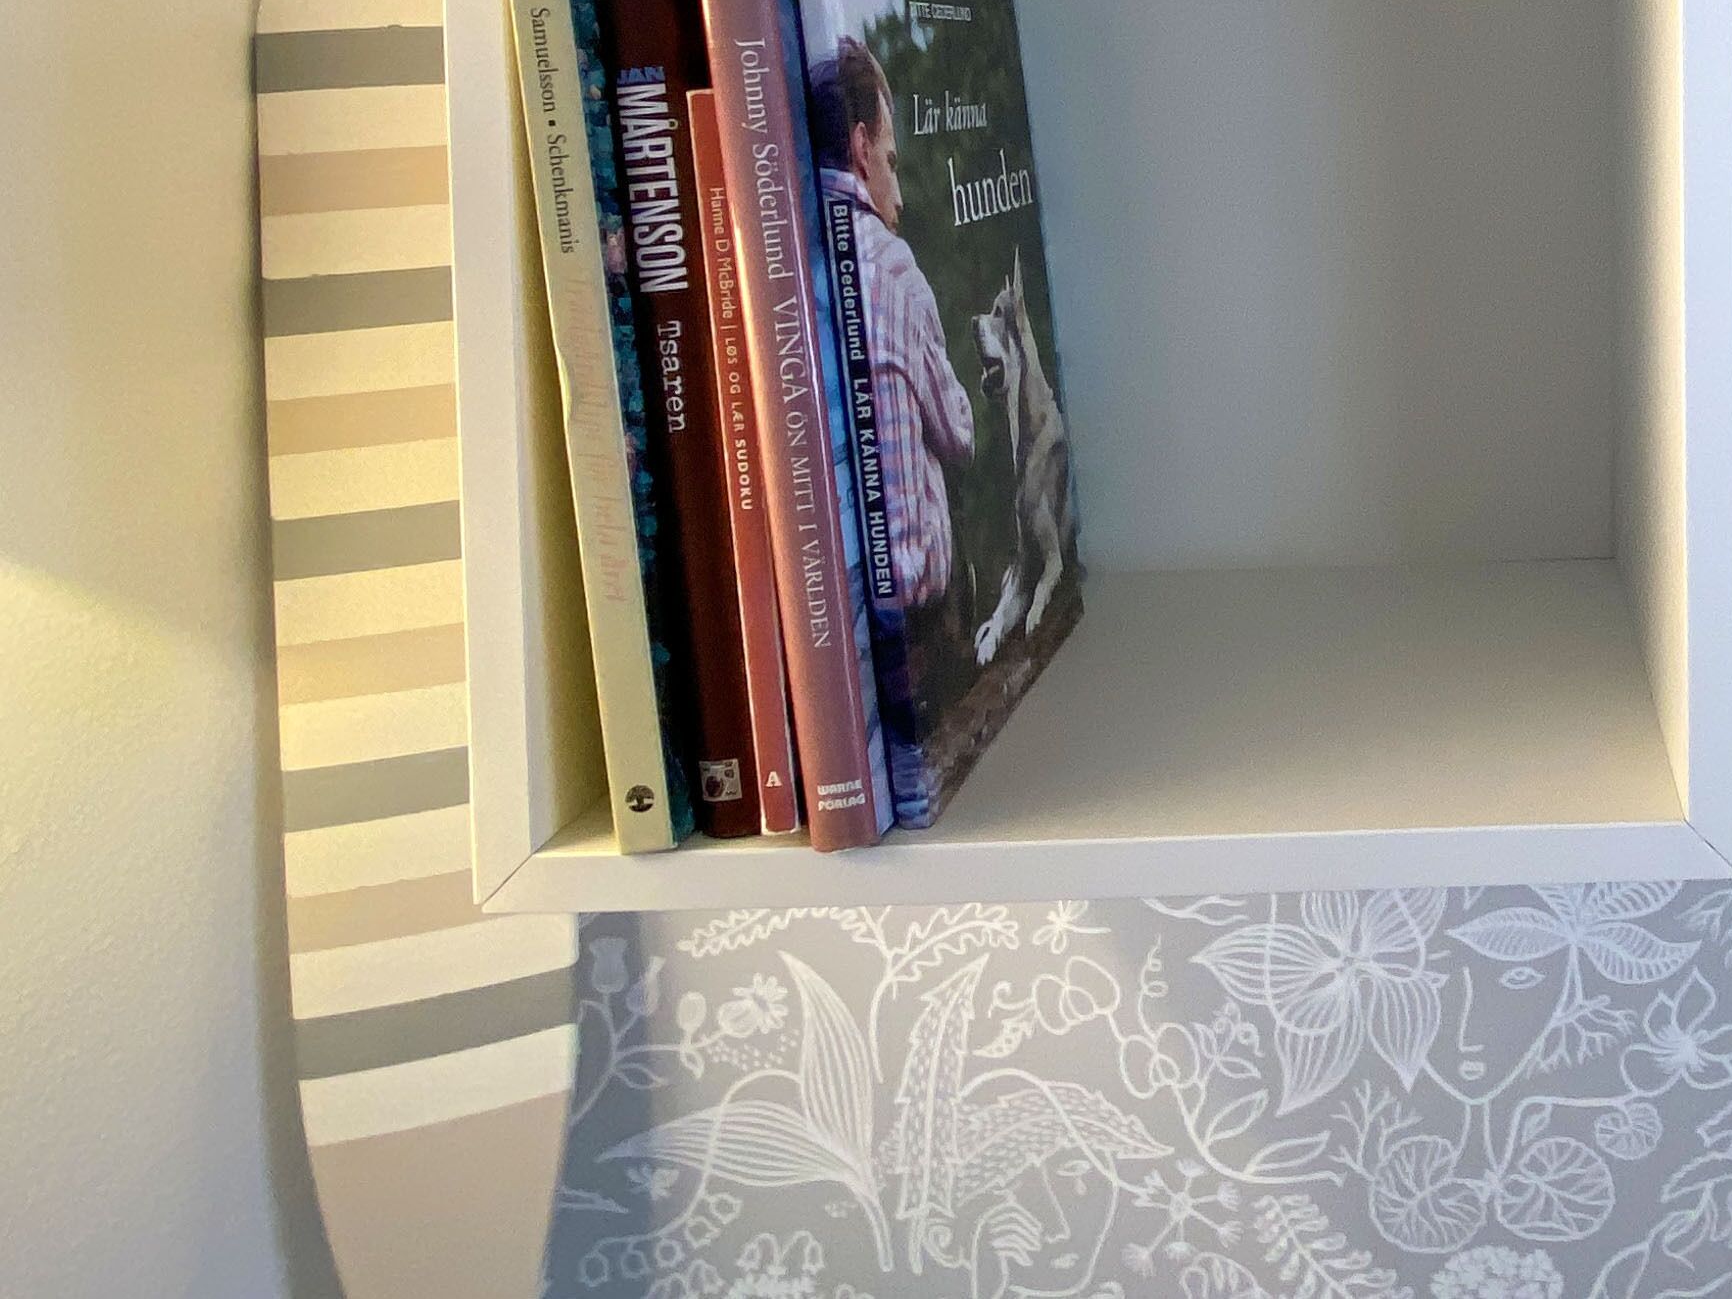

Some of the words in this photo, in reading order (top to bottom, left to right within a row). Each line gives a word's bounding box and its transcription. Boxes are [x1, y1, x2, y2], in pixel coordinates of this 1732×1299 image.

[734, 38, 770, 134] Johnny
[913, 94, 940, 135] Lär
[945, 90, 987, 133] känna
[531, 7, 558, 113] Samuelsson
[547, 134, 574, 253] Schenkmanis
[709, 187, 725, 235] Hanne
[752, 144, 794, 280] Söderlund
[948, 148, 1033, 226] hunden
[616, 83, 689, 292] MÅRTENSON
[657, 320, 686, 433] Tsaren
[832, 204, 850, 252] Bitte
[717, 257, 737, 319] McBride
[840, 260, 865, 361] Cederlund
[725, 337, 738, 364] LØS
[773, 295, 809, 404] VINGA
[728, 371, 741, 394] OG
[853, 378, 872, 419] LÄR
[731, 402, 744, 431] LÆR
[785, 411, 808, 447] ÖN
[735, 439, 752, 510] SUDOKU
[790, 456, 816, 511] MITT
[859, 428, 882, 501] KÄNNA
[798, 523, 818, 531] I
[869, 511, 893, 595] HUNDEN
[801, 539, 832, 649] VÄRLDEN
[766, 771, 782, 787] A
